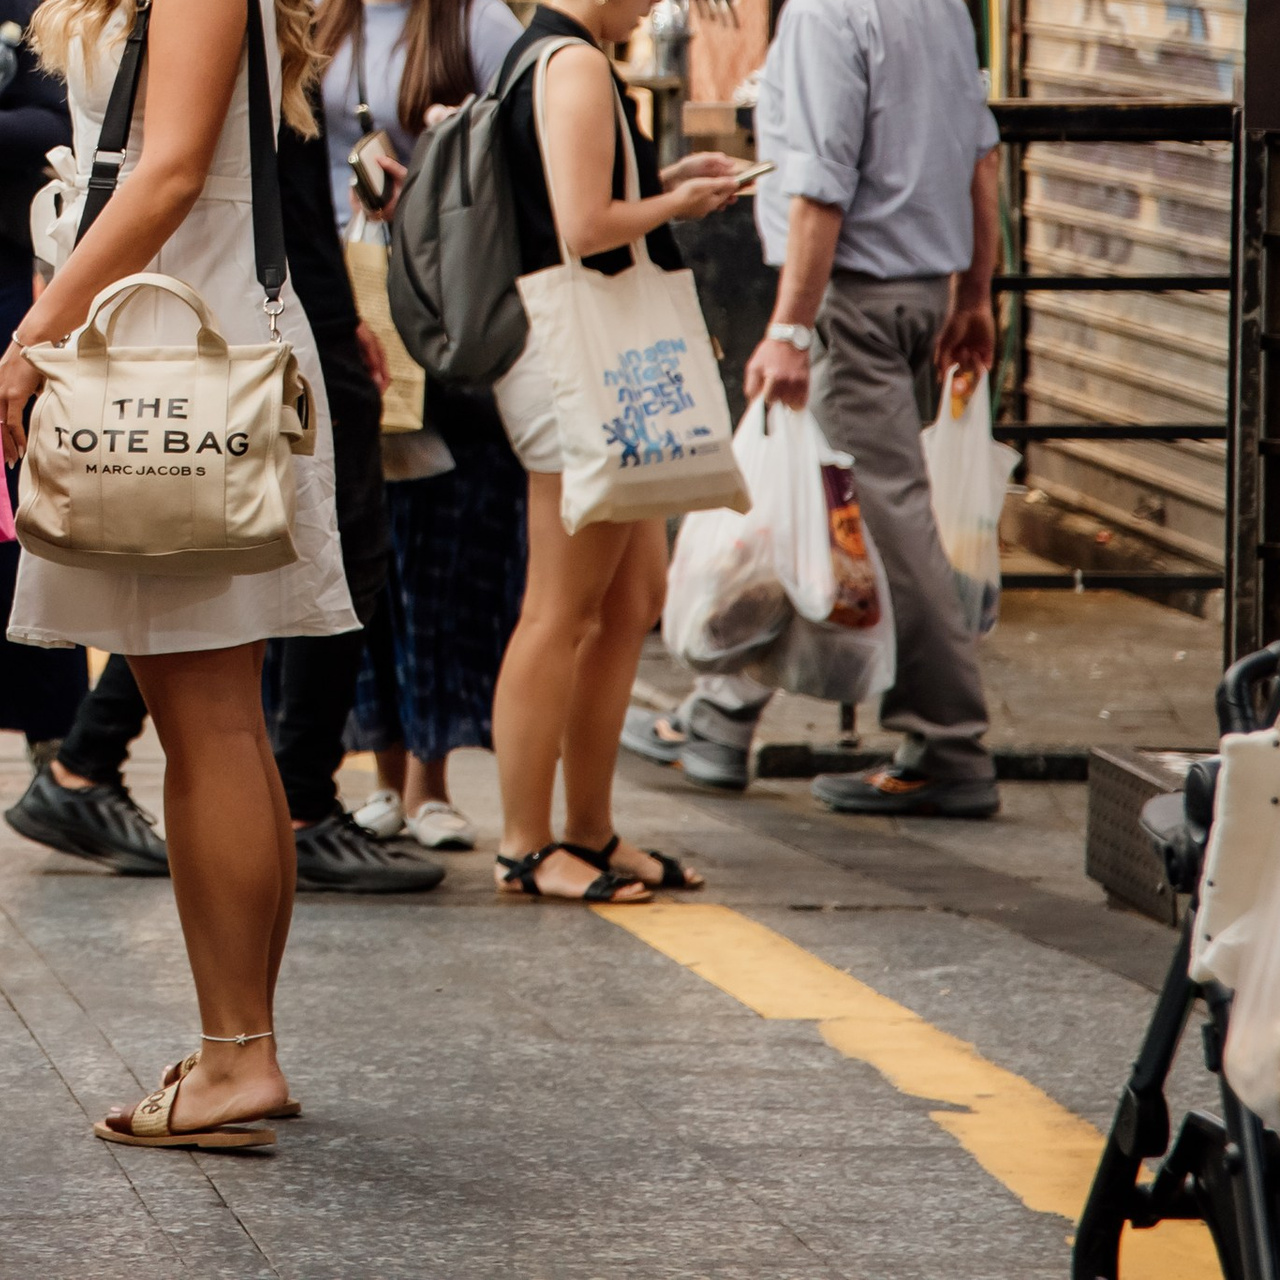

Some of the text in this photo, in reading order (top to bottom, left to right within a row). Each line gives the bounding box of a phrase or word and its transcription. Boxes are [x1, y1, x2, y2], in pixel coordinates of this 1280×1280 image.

[112, 398, 188, 419] THE
[54, 426, 249, 457] TOTE BAG
[86, 464, 206, 477] MARC JACOBS
